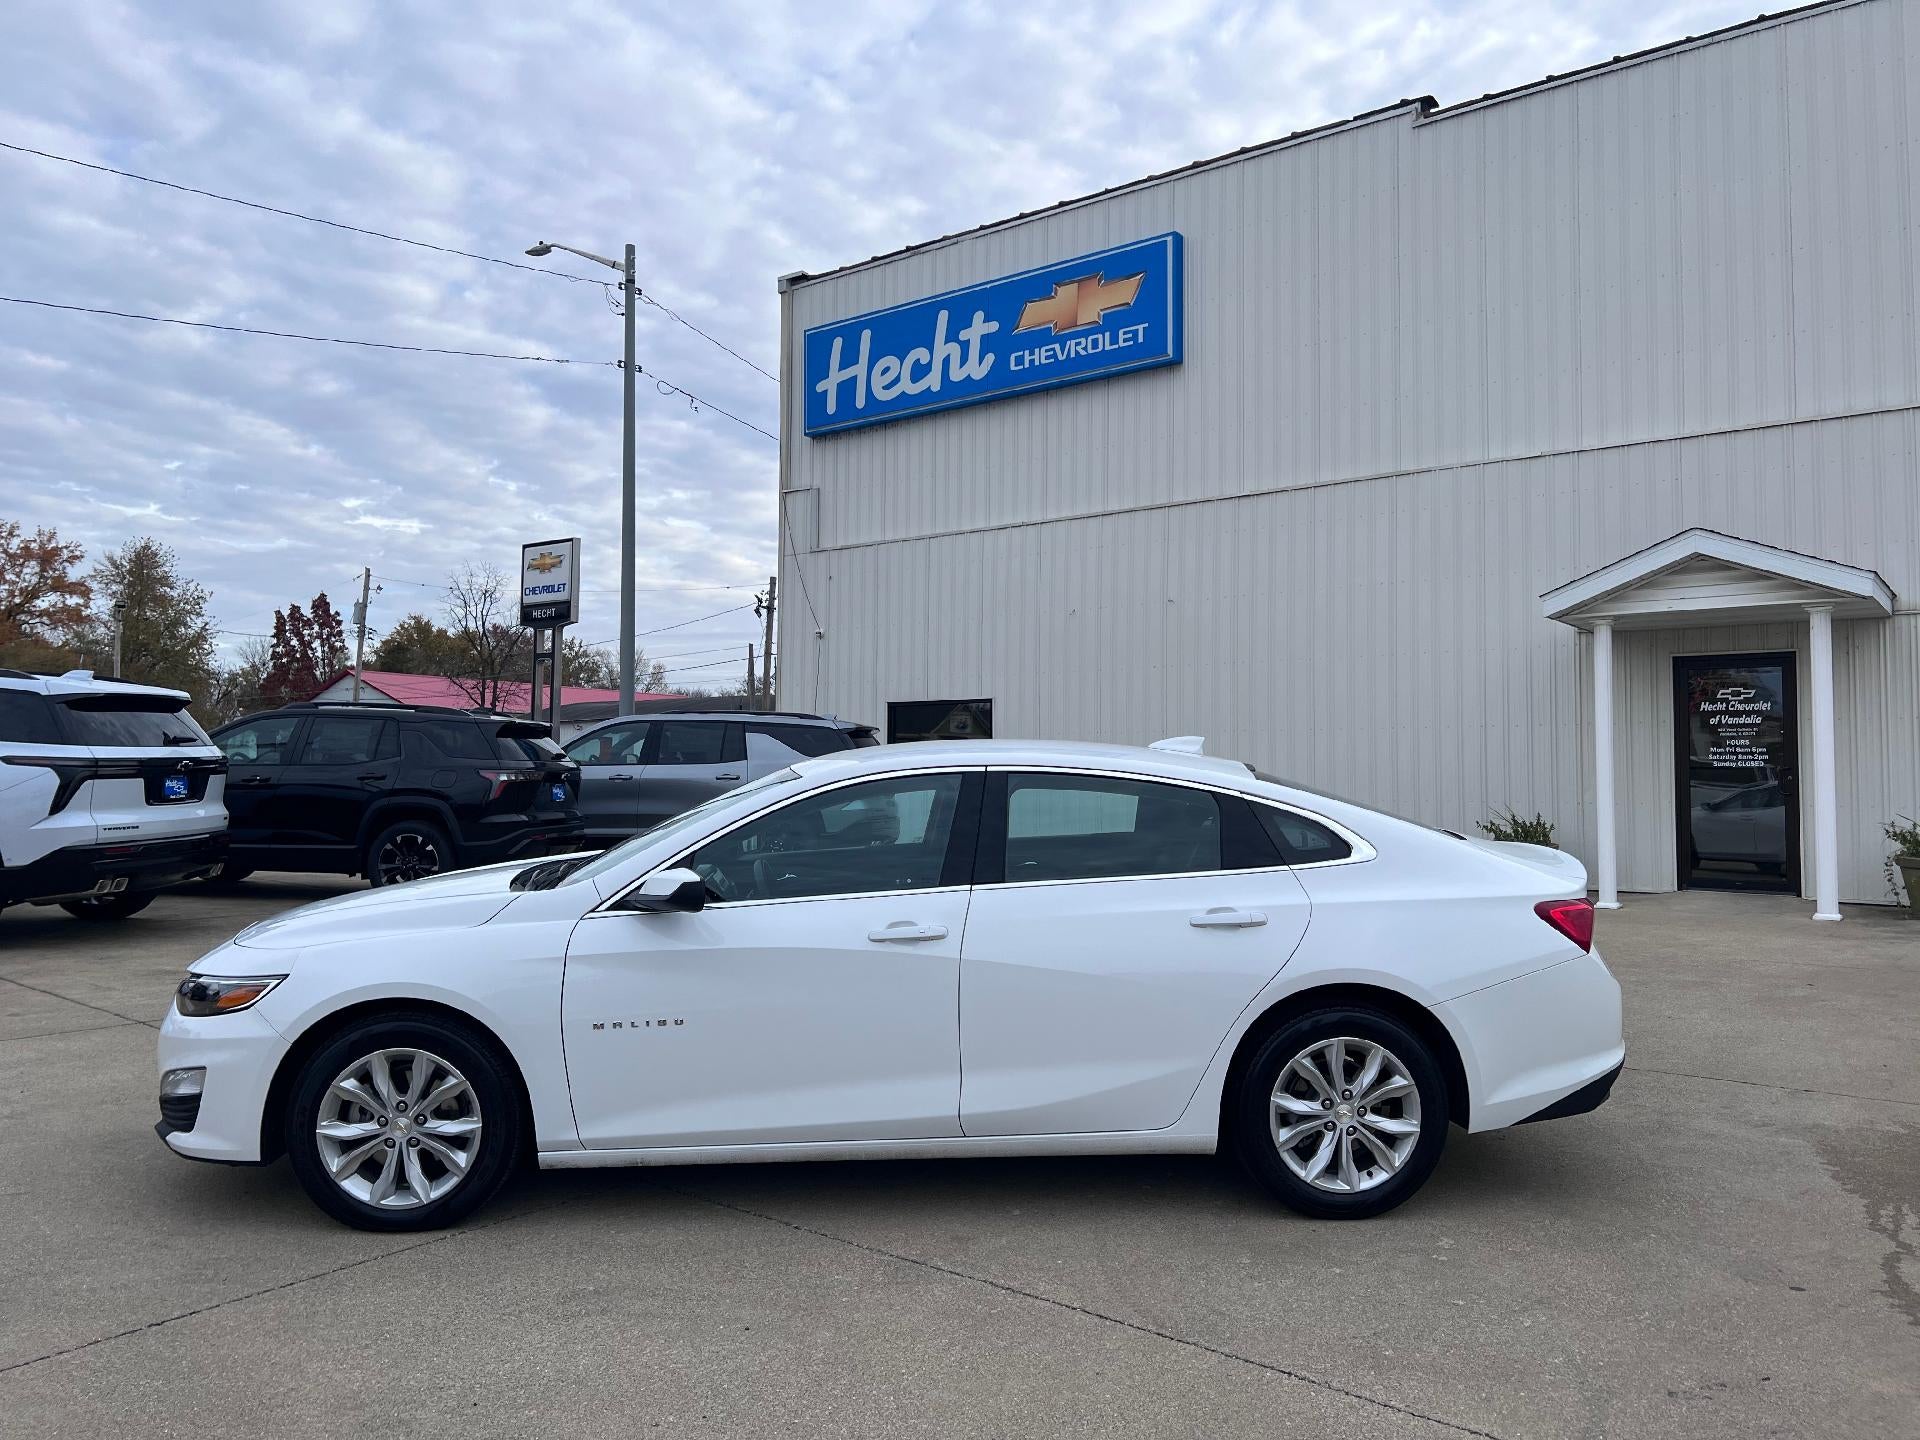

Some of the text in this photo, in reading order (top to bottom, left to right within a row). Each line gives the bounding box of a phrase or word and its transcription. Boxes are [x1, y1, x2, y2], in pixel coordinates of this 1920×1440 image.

[1009, 322, 1149, 371] CHEVROLET
[815, 309, 1000, 415] Hecht
[524, 583, 567, 597] CHEVROLET
[532, 608, 556, 618] HECHT
[1700, 700, 1771, 711] Hecht Chevrolet
[1709, 714, 1762, 724] of Vandalia
[592, 1018, 684, 1030] MALIBU
